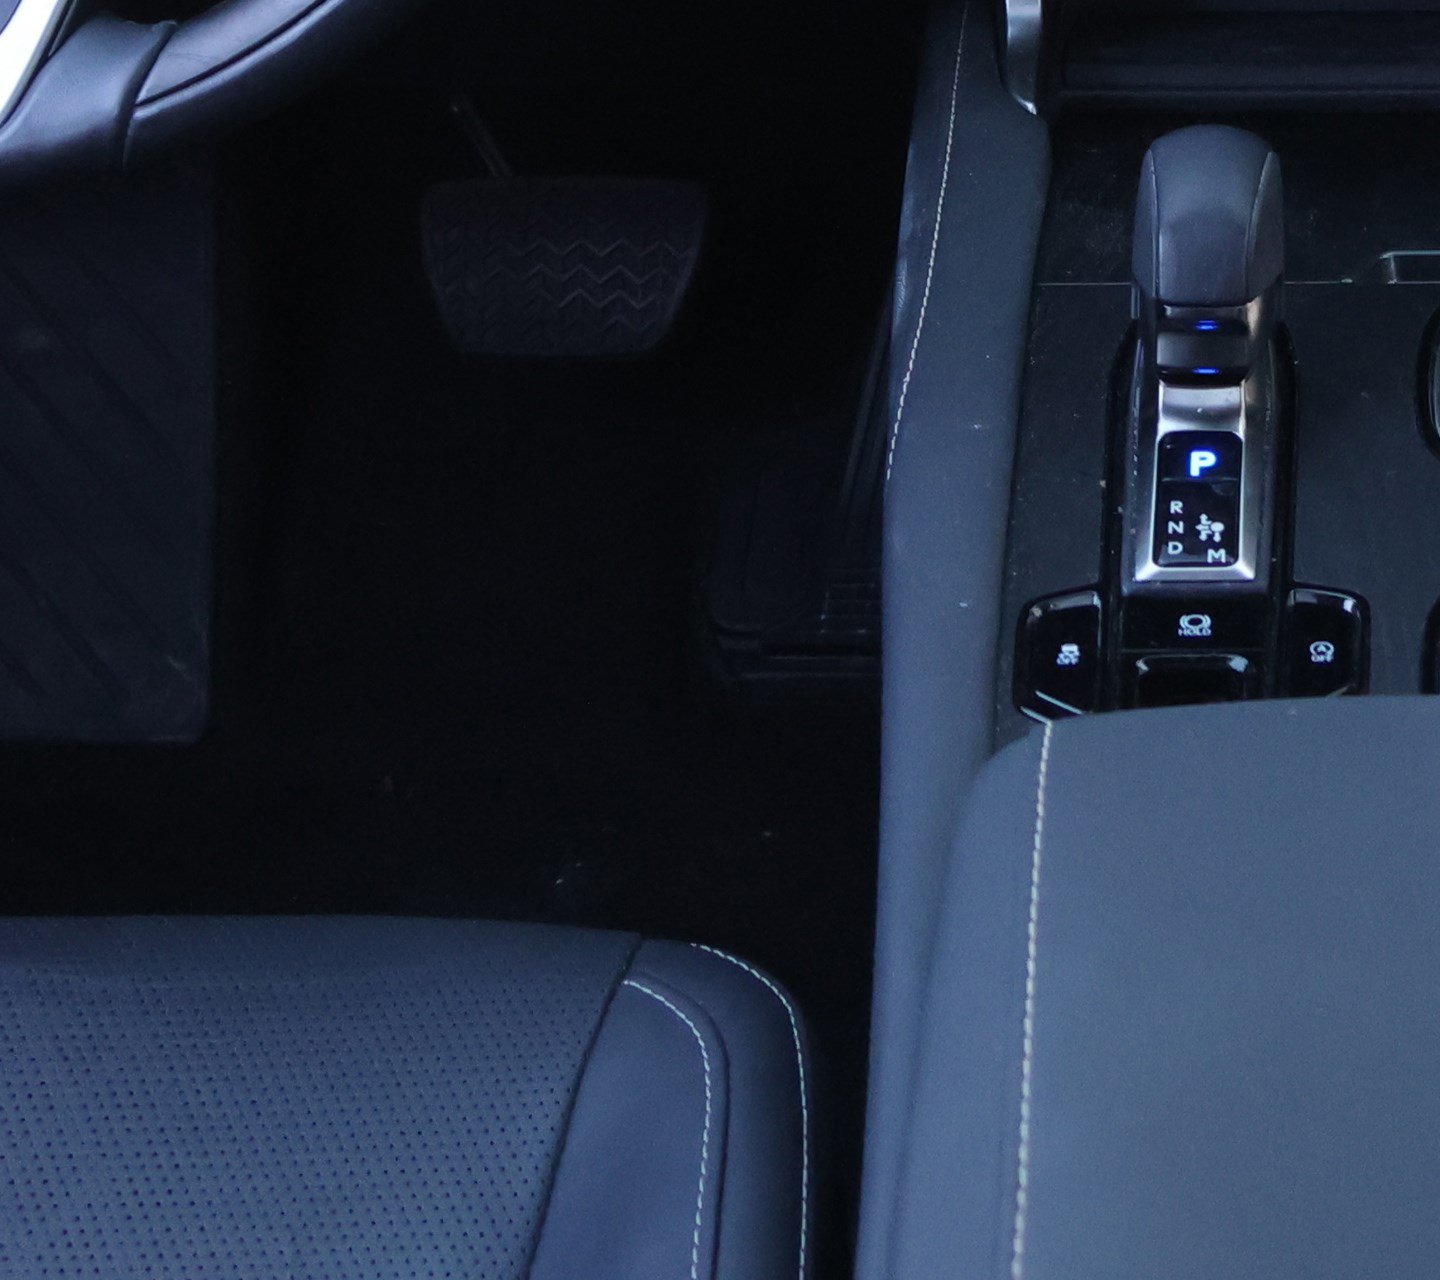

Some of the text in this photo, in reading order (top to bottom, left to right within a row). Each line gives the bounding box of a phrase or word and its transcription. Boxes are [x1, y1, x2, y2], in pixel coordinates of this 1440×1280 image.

[1189, 450, 1217, 477] P
[1169, 500, 1184, 515] R
[1167, 521, 1184, 535] N
[1167, 541, 1183, 556] D
[1207, 548, 1227, 563] M
[1178, 627, 1212, 637] HOLD
